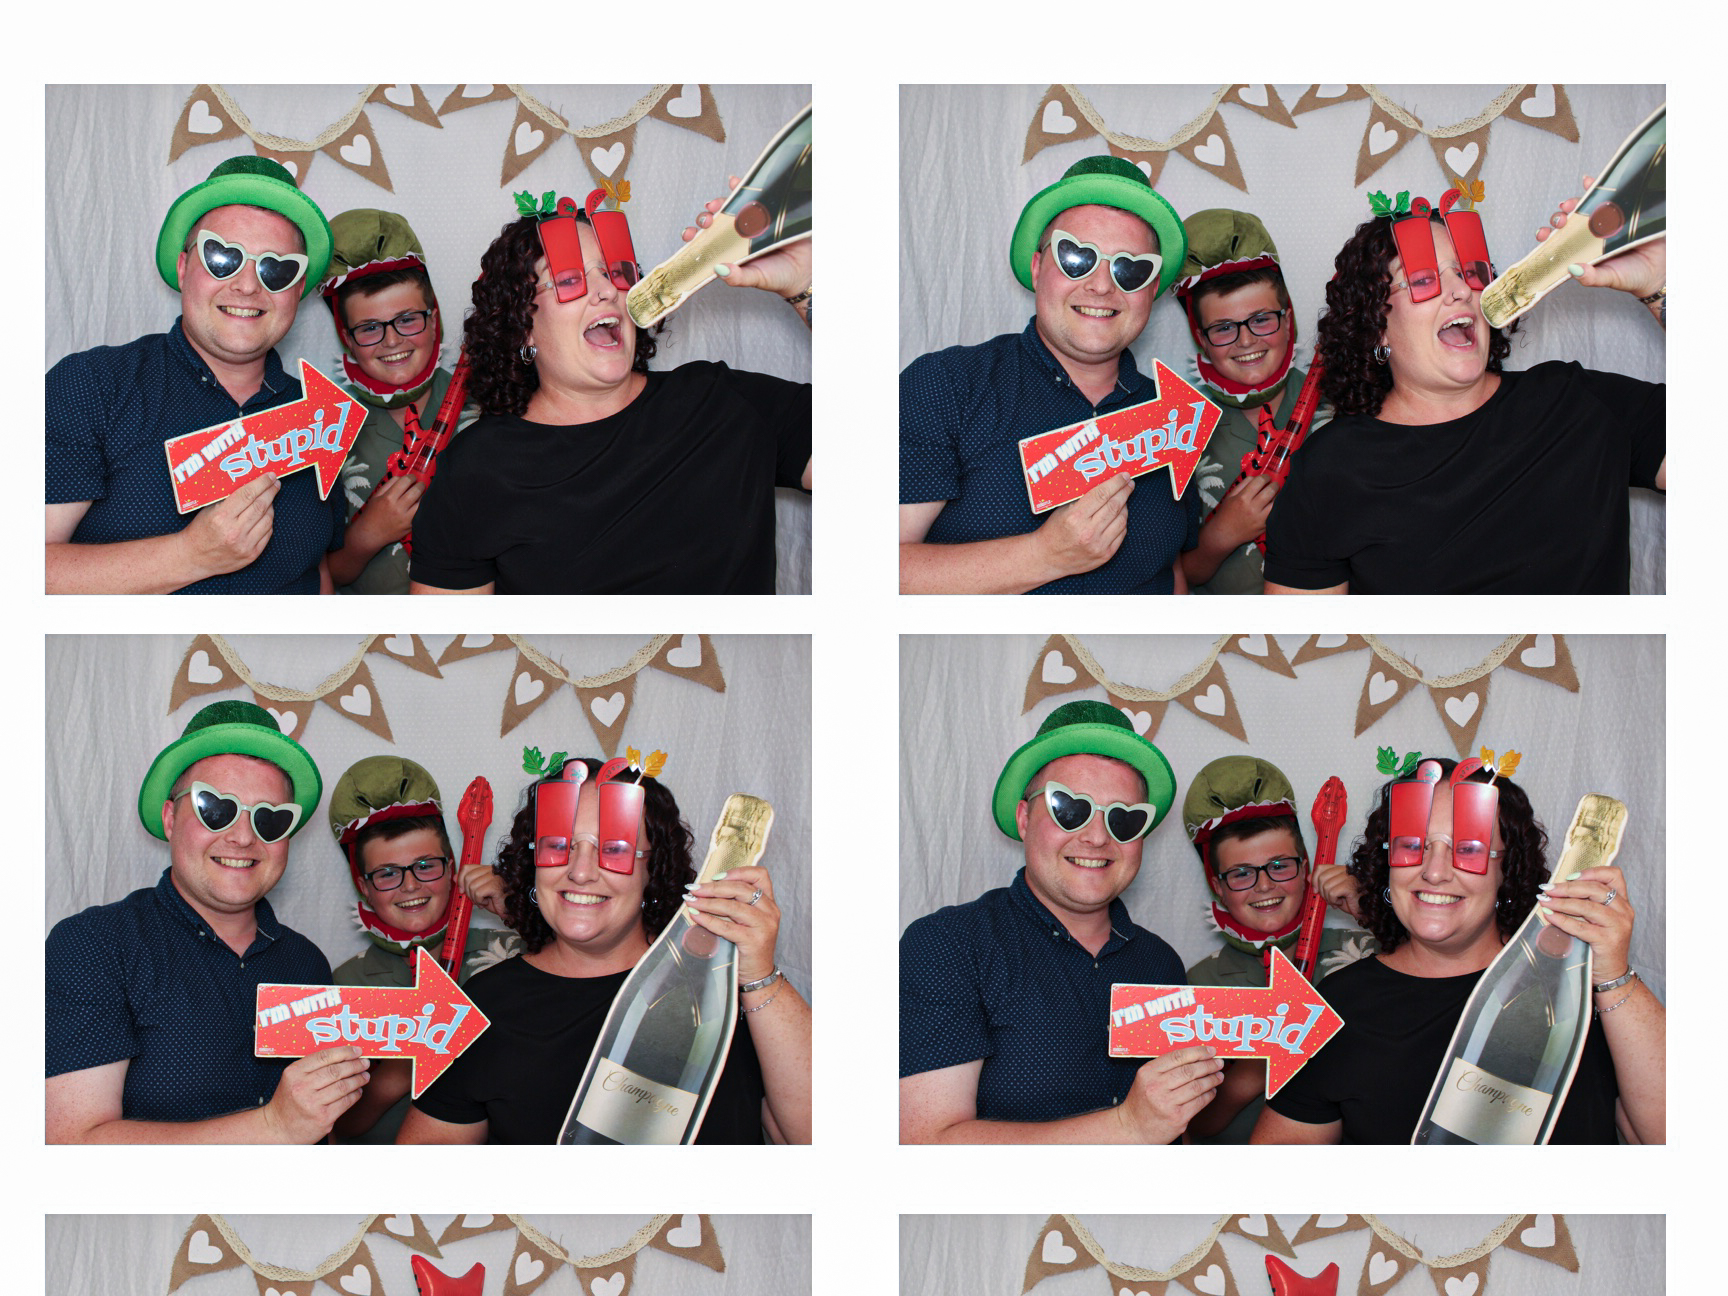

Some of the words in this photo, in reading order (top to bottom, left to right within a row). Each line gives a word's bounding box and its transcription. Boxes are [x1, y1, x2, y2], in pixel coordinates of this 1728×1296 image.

[201, 421, 247, 462] WITH
[219, 400, 352, 483] stupid
[1055, 421, 1101, 462] WITH
[1073, 400, 1206, 483] stupid
[290, 988, 342, 1016] WITH
[1144, 988, 1196, 1016] WITH
[305, 1003, 472, 1054] stupid
[1159, 1003, 1326, 1054] stupid
[602, 1069, 679, 1117] Champagne
[1456, 1069, 1533, 1117] Champagne
